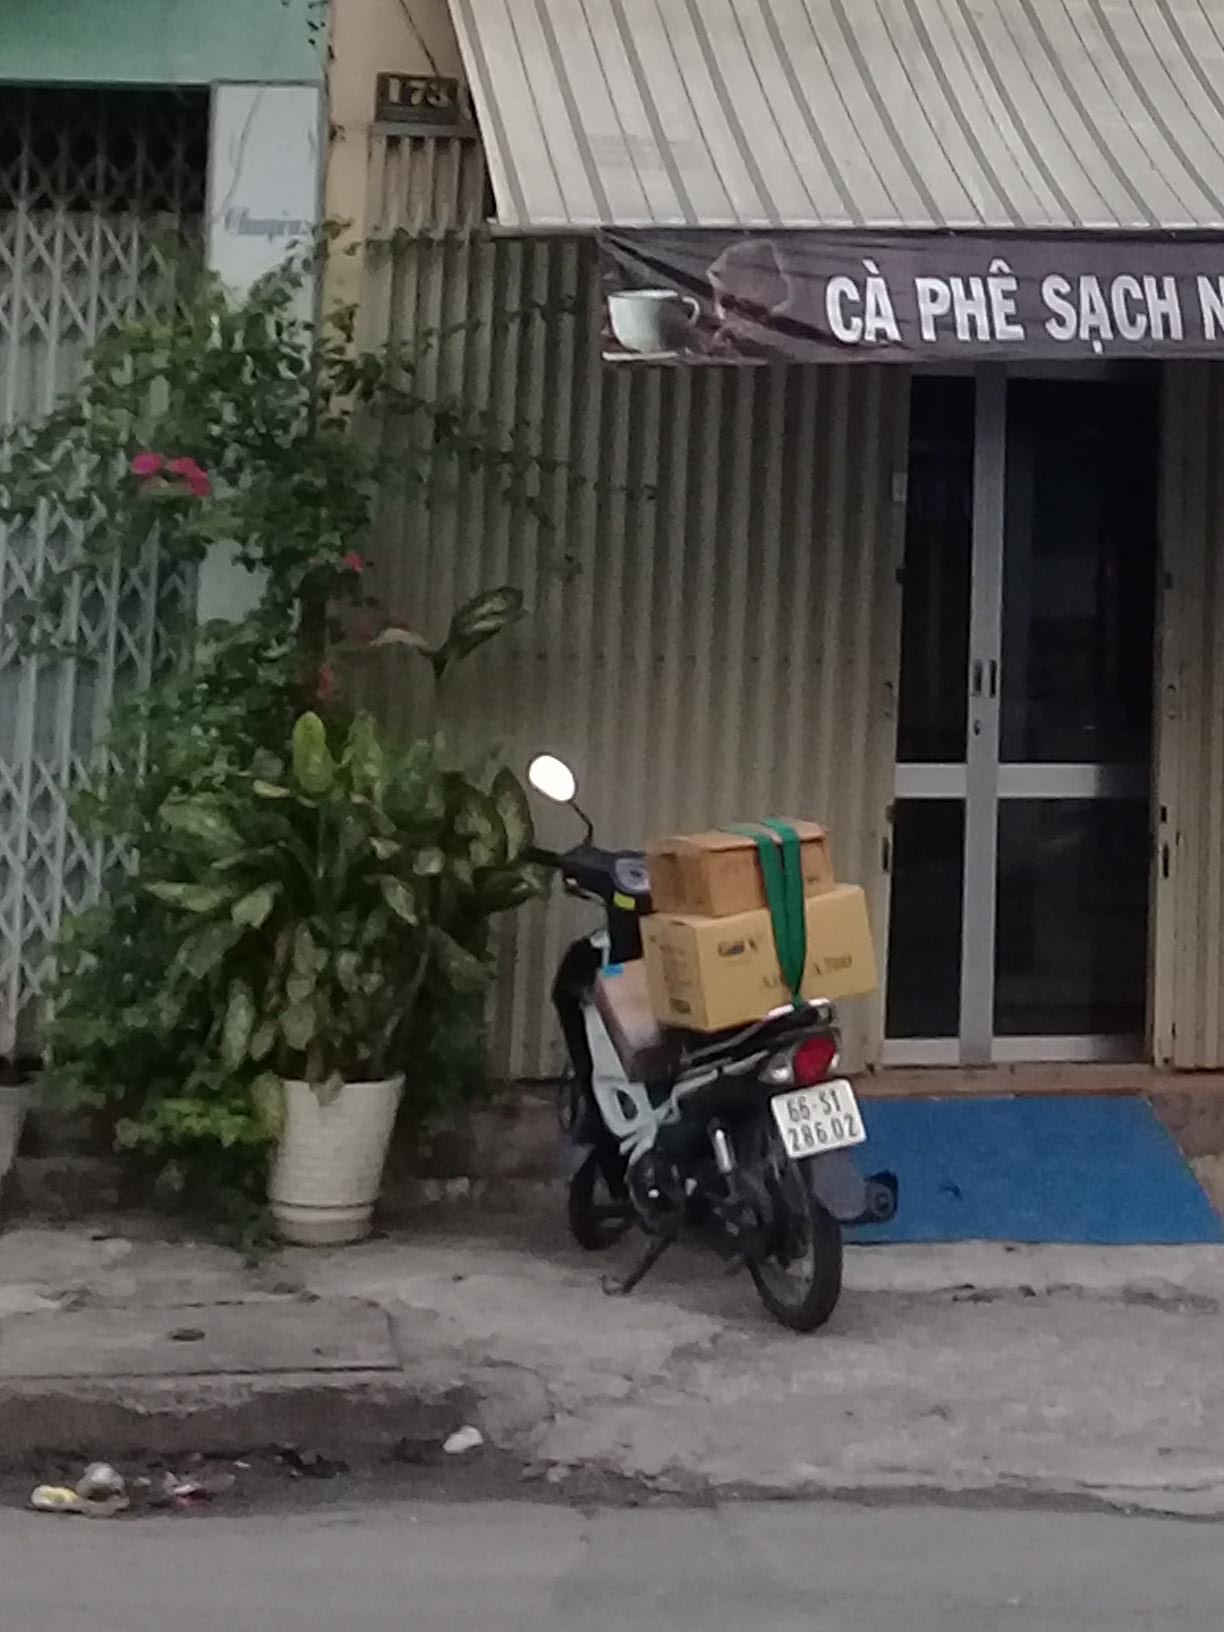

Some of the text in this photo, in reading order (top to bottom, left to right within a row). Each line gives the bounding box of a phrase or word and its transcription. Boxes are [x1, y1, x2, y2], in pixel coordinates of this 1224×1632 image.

[825, 260, 902, 343] CÀ
[915, 259, 1026, 343] PHÊ
[1041, 274, 1184, 354] SẠCH
